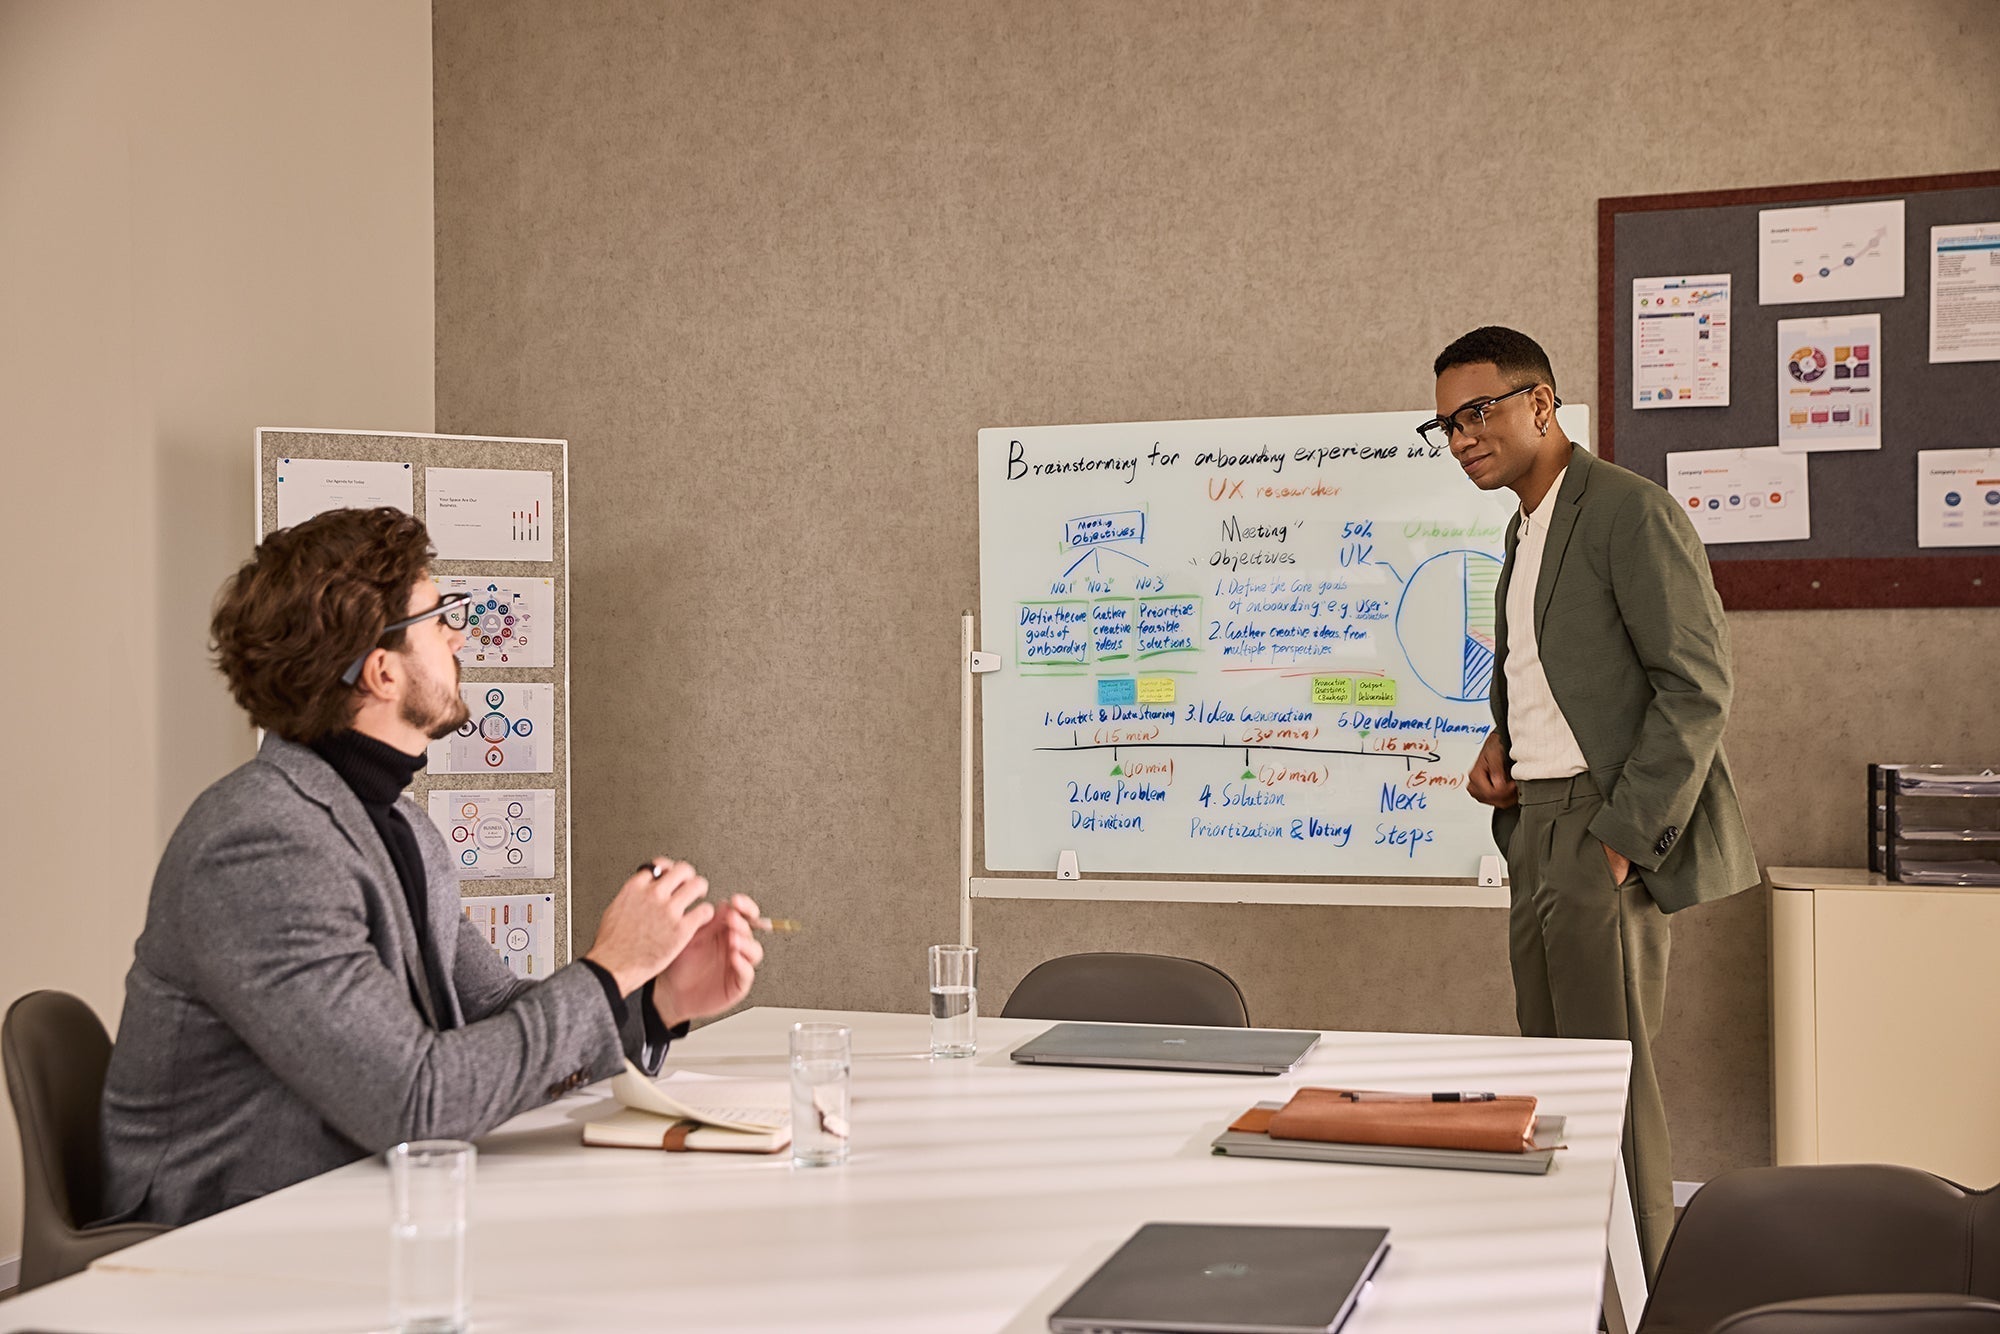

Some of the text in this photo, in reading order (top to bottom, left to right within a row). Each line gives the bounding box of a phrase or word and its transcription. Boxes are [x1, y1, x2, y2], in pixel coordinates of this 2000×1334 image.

[1007, 440, 1138, 484] Brainstorming
[1147, 441, 1180, 467] for
[1293, 442, 1399, 468] experience
[1407, 442, 1425, 459] in
[1208, 478, 1343, 501] UX researcher
[1072, 527, 1136, 546] Objectives
[1340, 519, 1374, 539] 50%
[1339, 543, 1374, 568] UK
[1228, 577, 1267, 598] Define
[1269, 575, 1287, 595] the
[1228, 597, 1243, 615] of
[1025, 625, 1070, 645] goals of
[1093, 621, 1131, 636] creative
[1225, 620, 1266, 640] Gather
[1027, 639, 1088, 663] onboarding
[1223, 639, 1333, 666] multiple perspectives
[1099, 708, 1108, 723] &
[1240, 705, 1312, 723] Generation
[1433, 715, 1491, 745] Planning
[1116, 779, 1167, 805] Problem
[1222, 782, 1285, 807] Solution
[1381, 782, 1427, 813] Next
[1071, 809, 1145, 832] Definition
[1290, 818, 1304, 840] &
[1308, 816, 1353, 847] Voting
[1374, 823, 1434, 858] Steps
